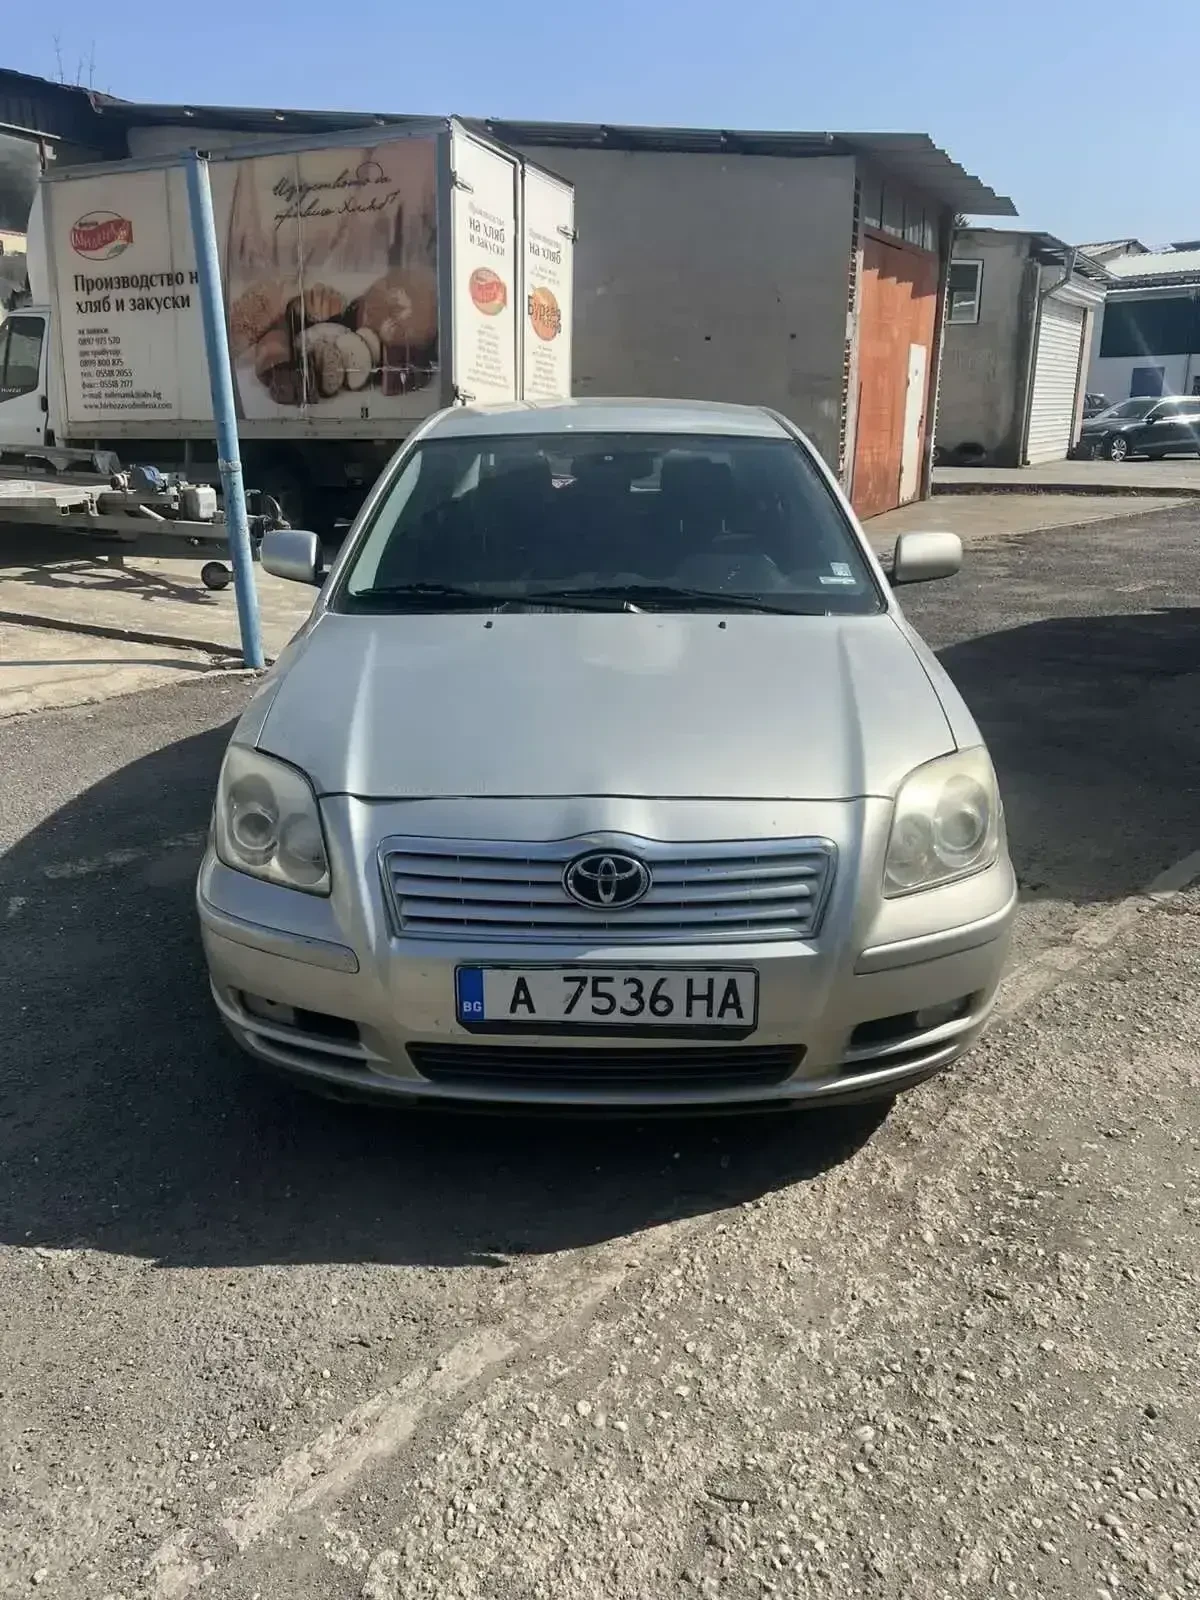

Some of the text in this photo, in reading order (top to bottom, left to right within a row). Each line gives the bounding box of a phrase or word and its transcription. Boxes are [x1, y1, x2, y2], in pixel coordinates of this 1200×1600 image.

[469, 216, 505, 244] на хляб
[469, 233, 505, 257] и закуски
[529, 241, 562, 265] на хляб
[74, 272, 184, 296] Производство
[76, 295, 191, 315] хляб и закуски
[462, 1001, 483, 1013] BG
[509, 975, 744, 1019] A 7536 HA
